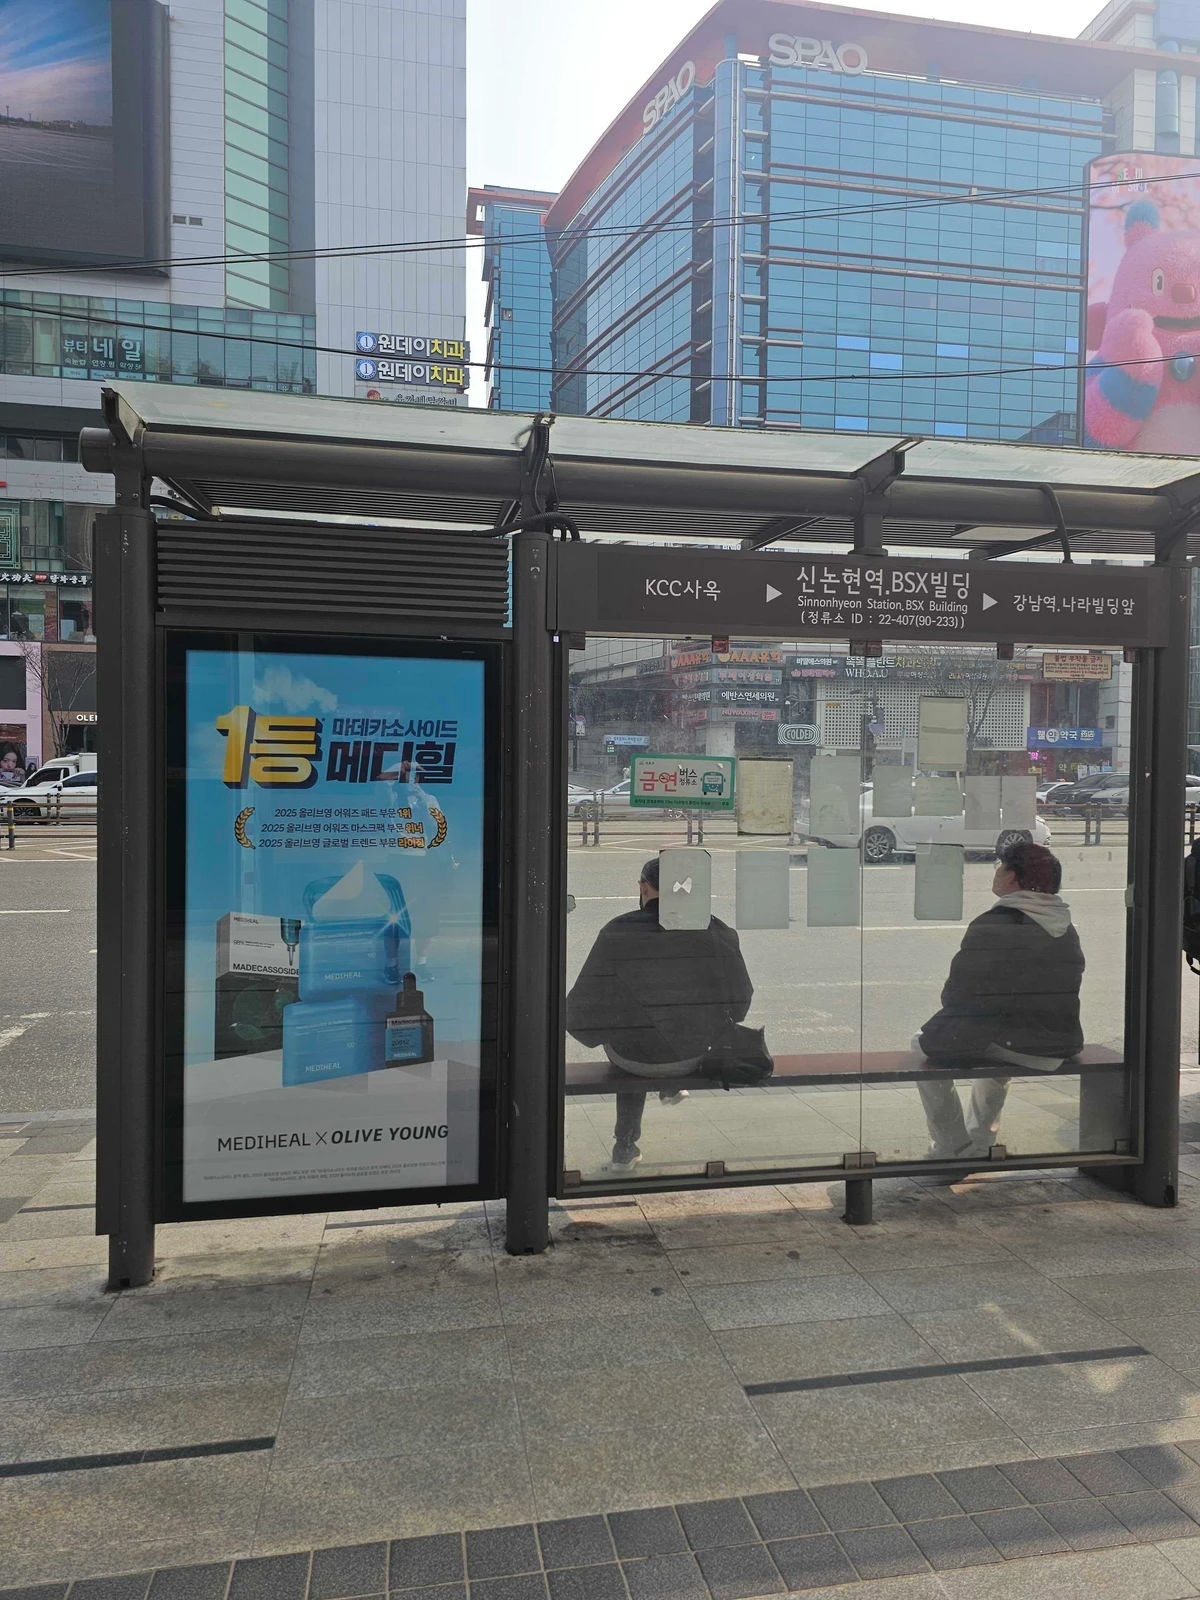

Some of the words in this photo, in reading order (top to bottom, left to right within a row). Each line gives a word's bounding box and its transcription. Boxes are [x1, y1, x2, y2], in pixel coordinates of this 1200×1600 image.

[768, 33, 868, 76] SPAO
[643, 61, 696, 135] SPAO
[63, 339, 88, 354] 뷰티
[377, 334, 466, 360] 원데이치과
[377, 361, 465, 386] 원데이치과
[796, 565, 970, 599] 신논현역.BSX빌딩
[645, 578, 721, 601] KCC사옥
[797, 595, 862, 610] Sinnonhyeon
[929, 600, 968, 615] Building
[1013, 594, 1135, 615] 강남역.나라빌딩앞
[851, 613, 863, 624] ID
[730, 649, 780, 664] AAA유학
[1054, 655, 1067, 663] 불법
[1090, 655, 1103, 663] 금지
[721, 690, 775, 702] 에반스연세의원
[332, 717, 458, 738] 마데카소사이드
[786, 728, 814, 740] FOLDER
[1060, 730, 1077, 741] 약국
[326, 740, 457, 784] 메디힐
[679, 767, 698, 779] 버스
[639, 771, 678, 792] 금연
[679, 778, 697, 787] 정류소
[274, 808, 298, 818] 2025
[299, 807, 332, 819] 올리브영
[334, 807, 360, 818] 어워즈
[361, 807, 378, 818] 패드
[379, 808, 396, 818] 부문
[397, 807, 412, 819] 1위
[261, 823, 285, 833] 2025
[286, 823, 322, 834] 올리브영
[323, 823, 349, 833] 어워즈
[351, 823, 385, 833] 마스크팩
[387, 823, 404, 833] 부문
[404, 823, 424, 834] 위너
[259, 838, 283, 848] 2025
[284, 838, 320, 848] 올리브영
[322, 838, 349, 848] 글로벌
[351, 838, 377, 848] 트렌드
[379, 838, 396, 848] 부문
[398, 837, 425, 849] 라이징
[233, 916, 259, 924] MEDIHEAL
[232, 962, 299, 976] MADECASSOSIDE
[324, 971, 362, 981] MEDIHEAL
[305, 1062, 341, 1073] MEDIHEAL
[217, 1132, 311, 1152] MEDIHEAL
[330, 1128, 383, 1145] OLIVE
[388, 1124, 449, 1141] YOUNG
